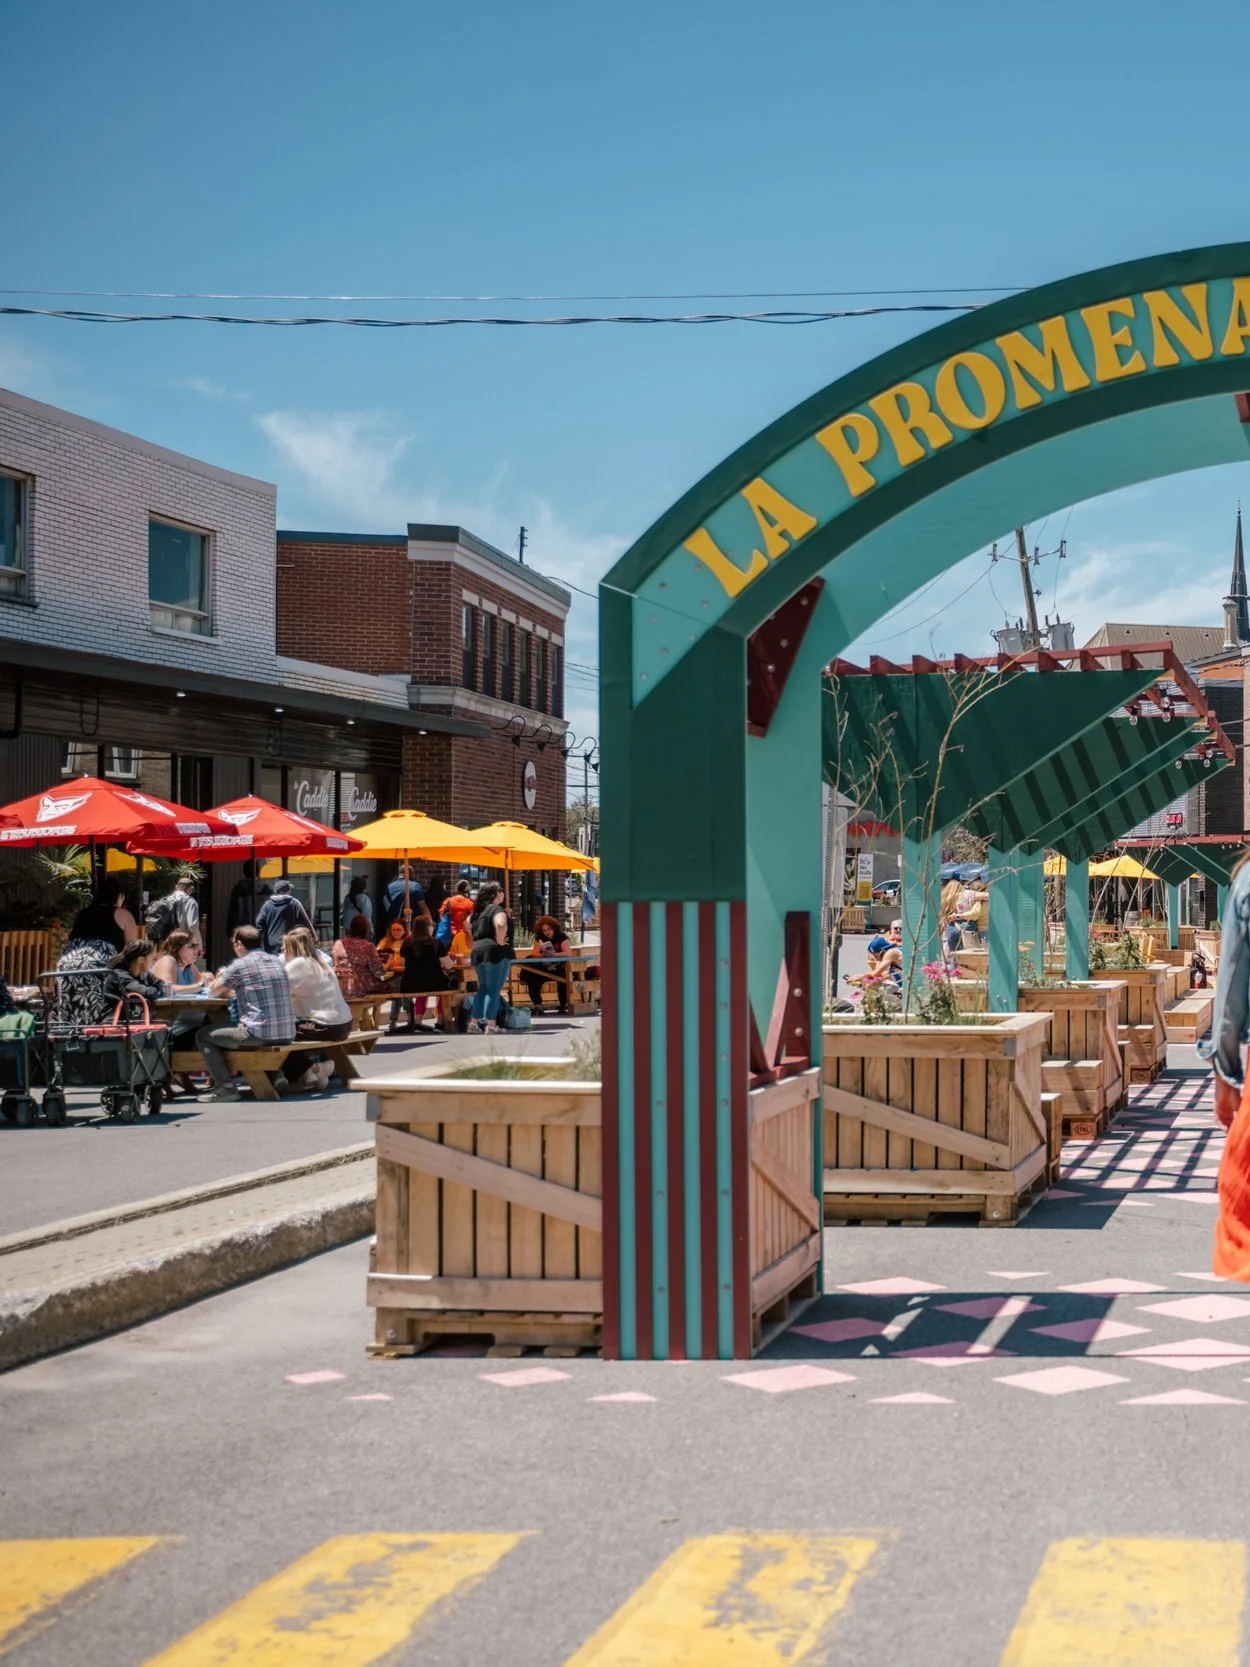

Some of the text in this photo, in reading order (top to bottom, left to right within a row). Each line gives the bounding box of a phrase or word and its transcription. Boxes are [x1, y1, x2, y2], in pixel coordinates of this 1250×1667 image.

[684, 477, 818, 598] LA
[296, 780, 329, 816] Caddie
[347, 786, 378, 821] Caddie
